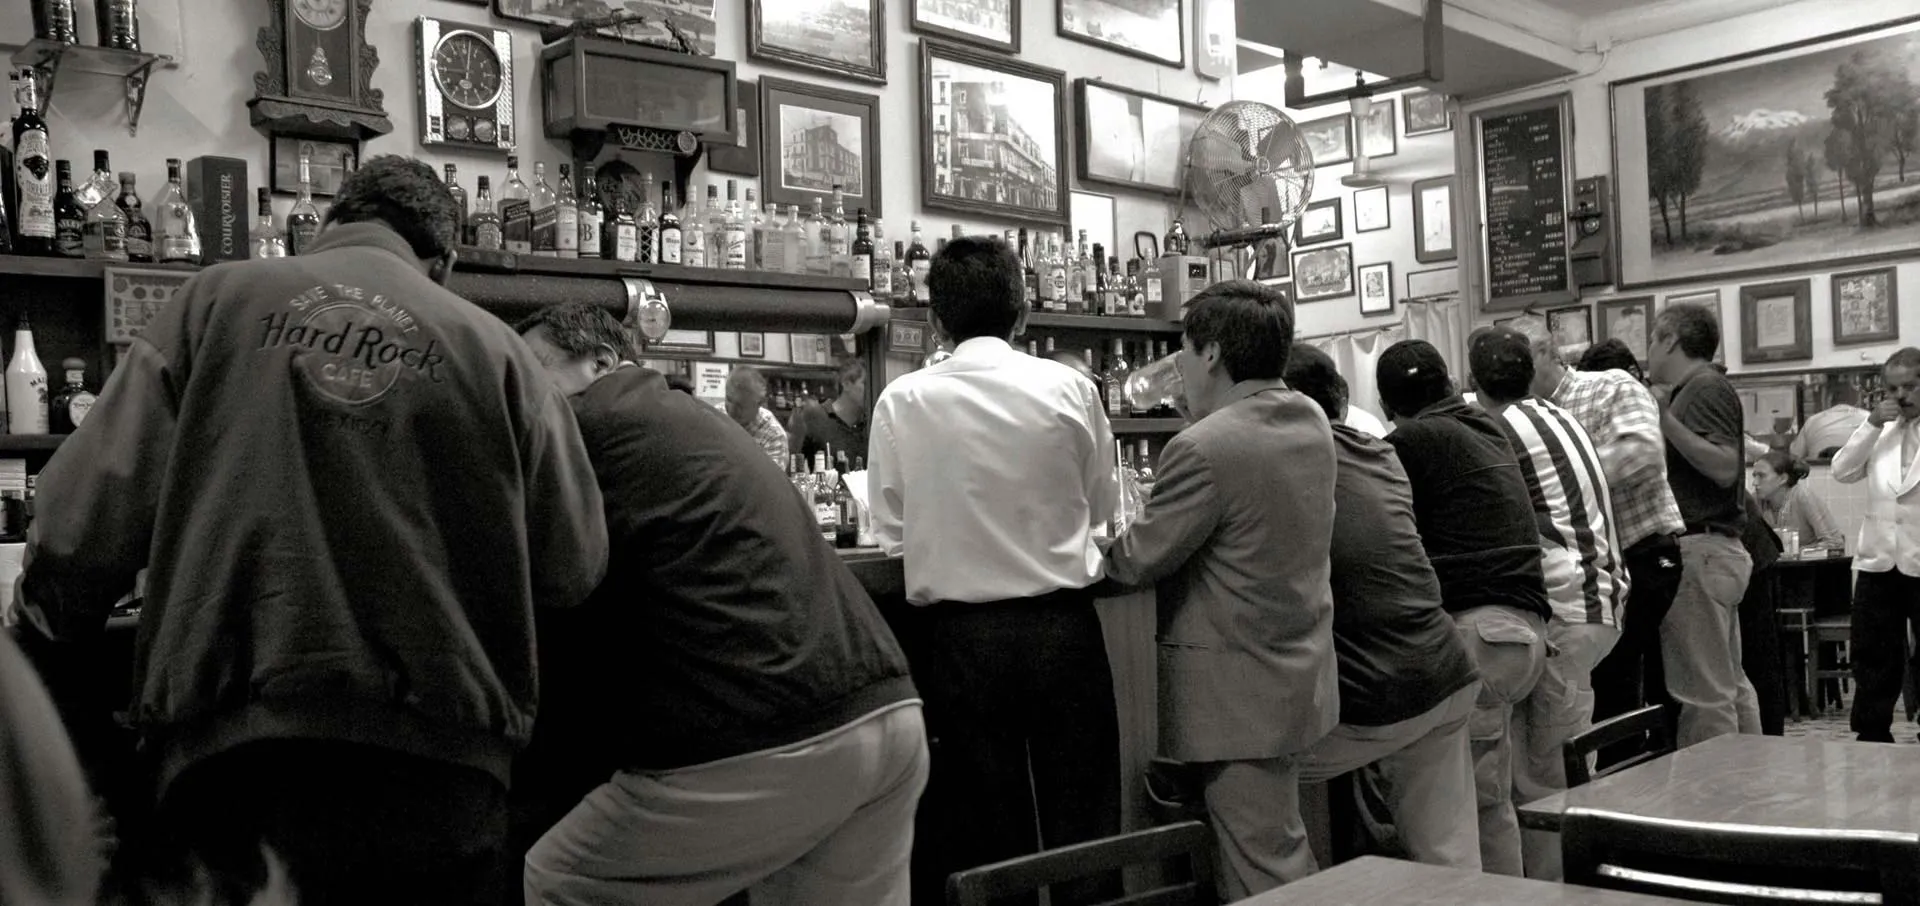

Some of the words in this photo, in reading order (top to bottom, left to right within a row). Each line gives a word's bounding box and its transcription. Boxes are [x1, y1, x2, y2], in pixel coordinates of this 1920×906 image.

[220, 173, 236, 255] COURVOISIER
[289, 285, 328, 311] SAVE
[332, 283, 364, 300] THE
[371, 294, 418, 334] PLANET
[257, 311, 353, 355] Hard
[353, 325, 445, 383] Rock
[322, 363, 375, 388] CAFE
